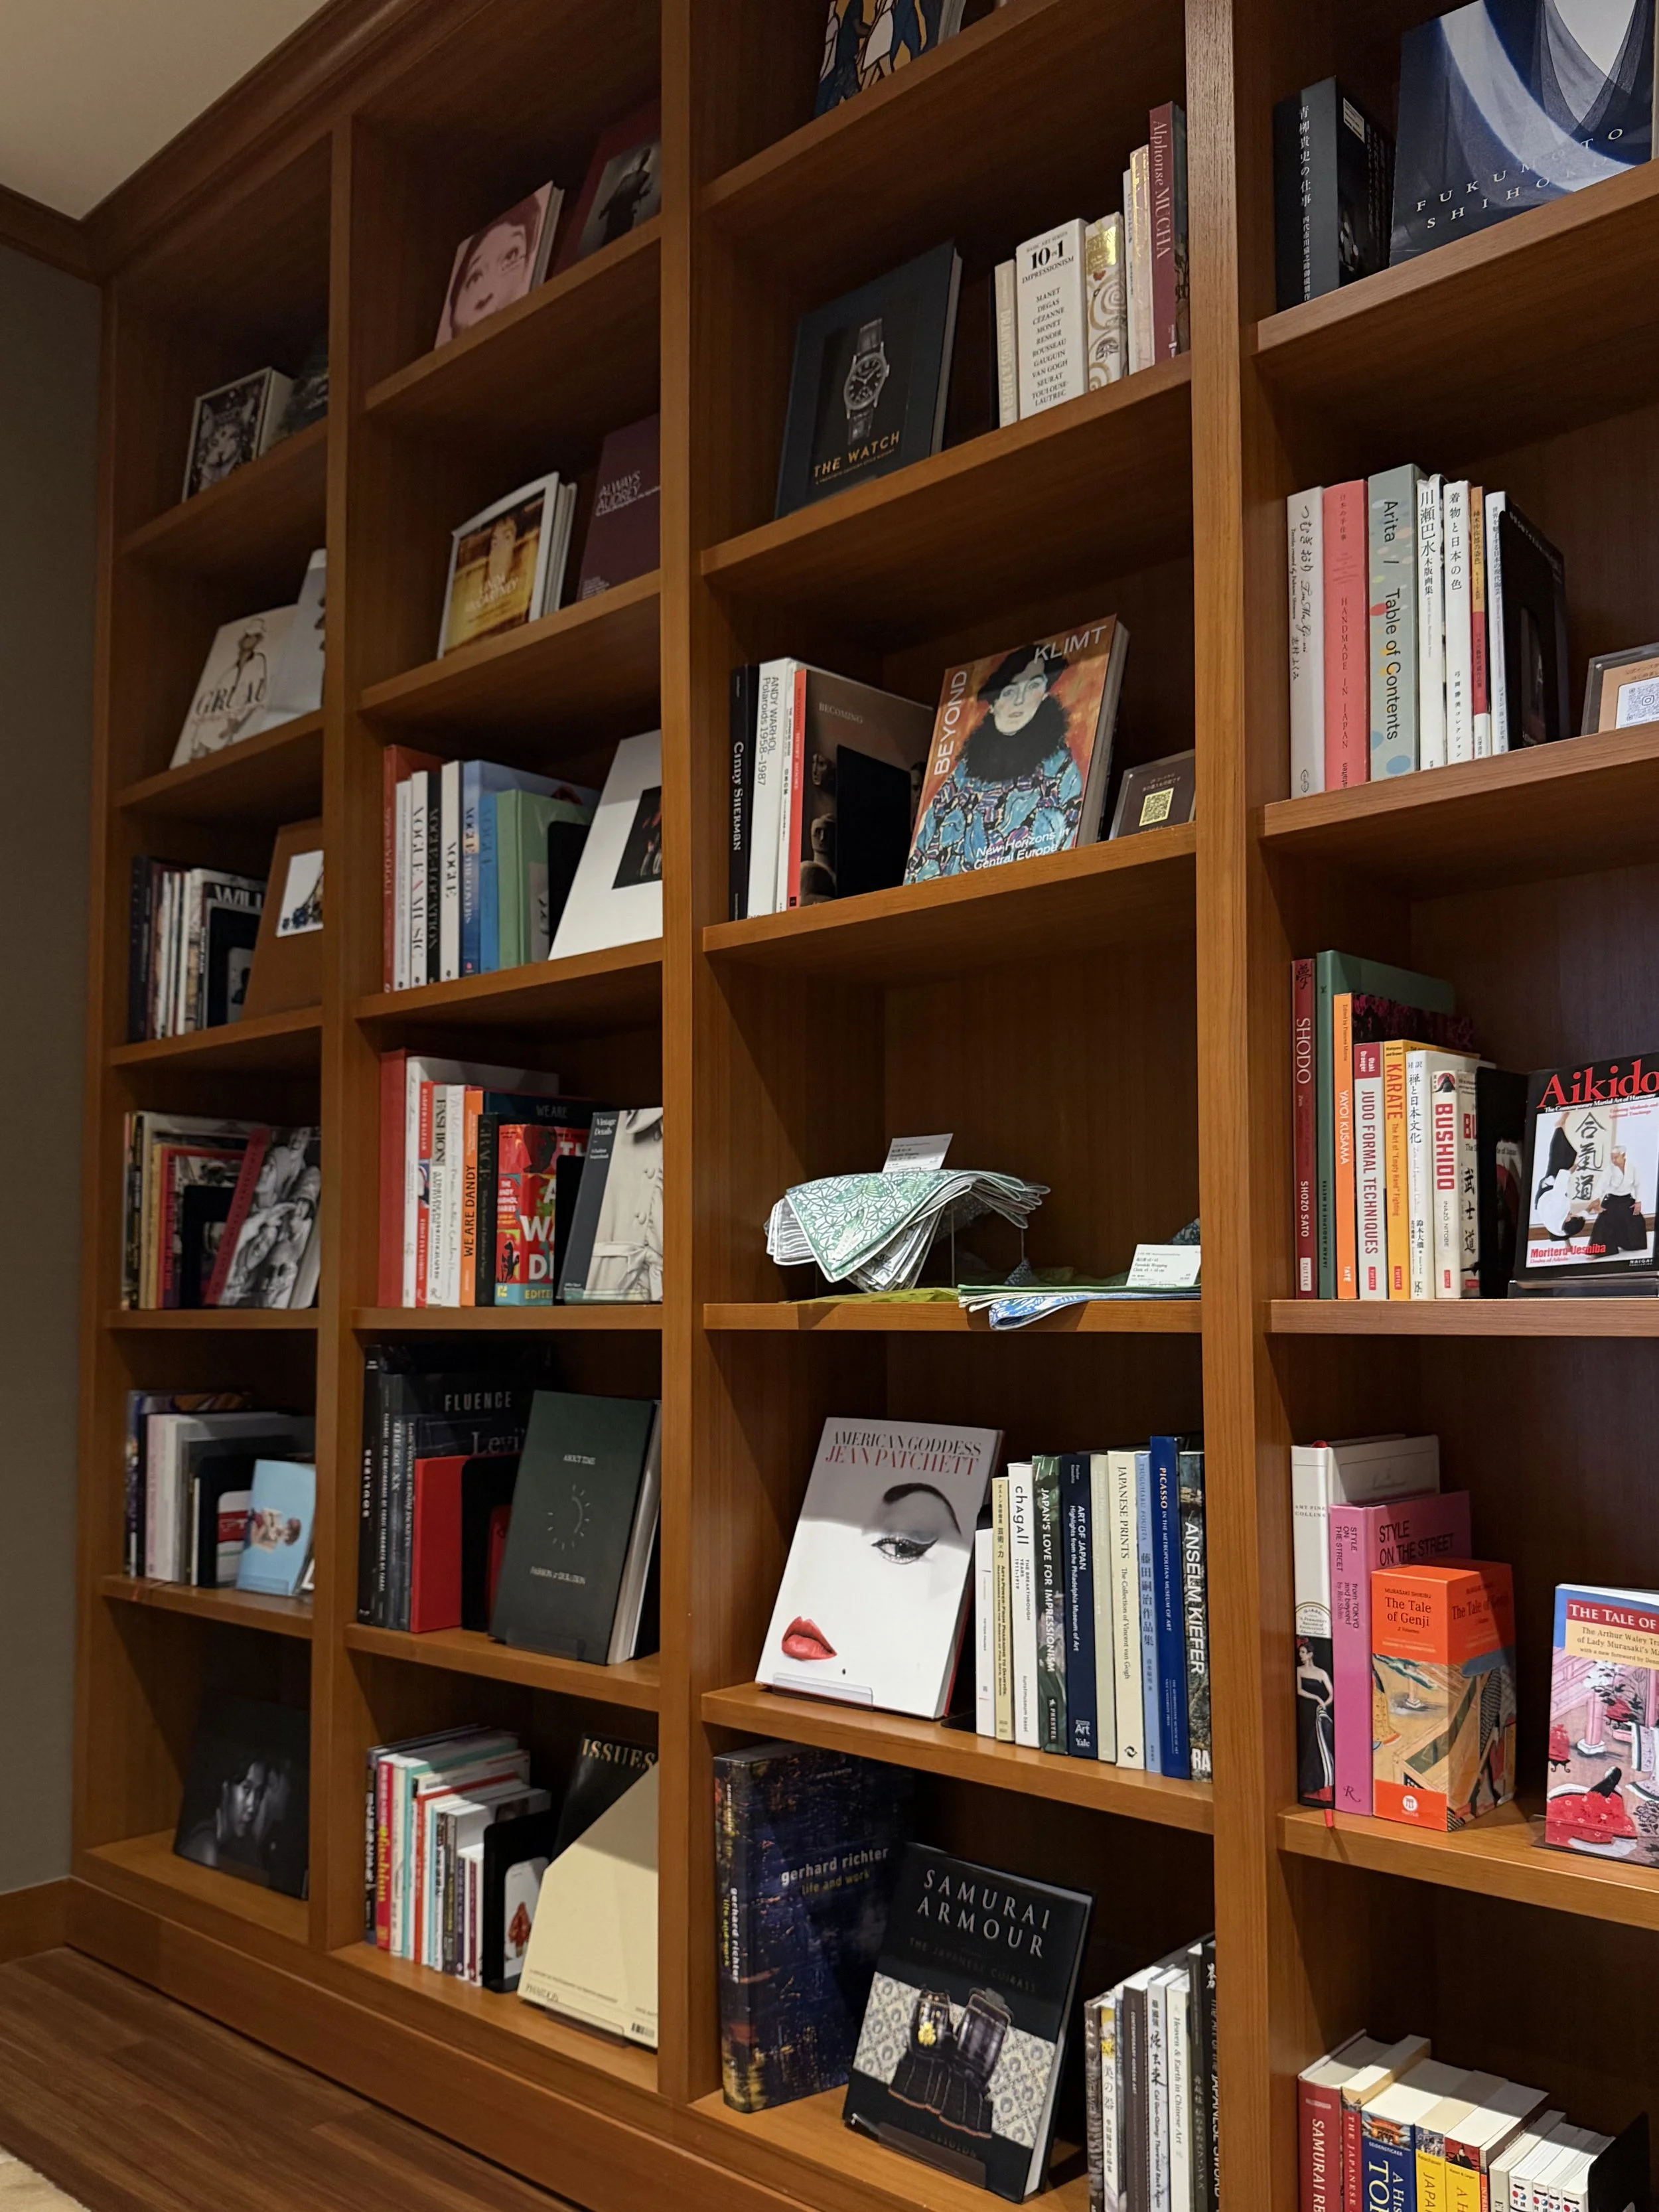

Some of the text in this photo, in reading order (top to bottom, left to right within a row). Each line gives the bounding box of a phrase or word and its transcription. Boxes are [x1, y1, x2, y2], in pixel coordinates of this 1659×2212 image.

[1151, 120, 1172, 259] Alphonse MUCHA
[1022, 256, 1074, 284] IMPRESSIONISM
[1031, 246, 1050, 270] 10
[1035, 287, 1060, 303] MANET
[1037, 299, 1060, 313] DEGAS
[1036, 330, 1062, 345] RENOIR
[1037, 319, 1062, 334] MONET
[814, 457, 841, 478] THE
[848, 430, 900, 464] WATCH
[1299, 504, 1313, 573] つむぎおり
[1420, 489, 1436, 557] 川瀬巴水
[1449, 492, 1463, 591] 着物と日本の色
[1424, 557, 1434, 596] 木版画集
[1383, 500, 1402, 741] Arita Table of Contents
[1033, 625, 1107, 664] KLIMT
[760, 678, 771, 726] Polaroids
[1341, 679, 1348, 696] IN
[769, 676, 780, 755] ANDY WARHOL
[818, 701, 864, 725] BECOMING
[934, 670, 968, 776] BEYOND
[465, 806, 475, 854] VOGUE
[976, 830, 1056, 858] New Horizons
[446, 842, 457, 899] VOGUE
[974, 843, 1058, 870] Central Europe
[1296, 1017, 1312, 1084] SHODO
[1387, 1063, 1403, 1120] KARATE
[1536, 1059, 1659, 1109] Aikido
[1630, 1092, 1657, 1102] Harmony
[596, 1118, 617, 1127] Vintage
[1339, 1090, 1350, 1165] YAYOI KUSAMA
[1409, 1073, 1421, 1144] 禅と日本文化
[435, 1099, 447, 1165] FASHION
[479, 1120, 492, 1181] GRACE
[1435, 1103, 1455, 1191] BUSHIDO
[1362, 1090, 1378, 1254] JUDO FORMAL TECHNIQUES
[1572, 1112, 1607, 1201] 合氣道
[465, 1165, 476, 1257] WE ARE DANDY
[1300, 1180, 1309, 1238] SHOZO SATO
[1463, 1167, 1476, 1254] 武士道
[445, 1391, 512, 1412] FLUENCE
[826, 1445, 979, 1476] JEAN PATCHETT
[835, 1431, 982, 1457] AMERICAN GODDESS
[1118, 1466, 1128, 1520] JAPANESE
[1159, 1467, 1168, 1509] PICASSO
[1077, 1505, 1087, 1570] ART OF JAPAN
[1120, 1520, 1129, 1559] PRINTS
[1343, 1526, 1350, 1538] ON
[1379, 1520, 1410, 1544] STYLE
[1379, 1532, 1454, 1567] ON THE STREET
[1043, 1534, 1056, 1672] LOVE FOR IMPRESSIONISM
[1141, 1552, 1154, 1646] 藤田嗣治作品集
[1185, 1522, 1205, 1675] ANSELM KIEFER
[1385, 1596, 1431, 1613] The Tale
[1569, 1603, 1657, 1630] THE TALE OF
[1387, 1611, 1430, 1629] of Genji
[1581, 1627, 1647, 1645] The Arthur Waley
[1587, 1637, 1648, 1654] Lady Murasaki's
[1074, 1724, 1090, 1735] Art
[1076, 1737, 1090, 1747] Yale
[583, 1738, 656, 1770] ISSUES
[781, 1848, 889, 1887] gerhard richter
[802, 1871, 870, 1896] life and work
[730, 1887, 739, 1938] gerhard
[924, 1868, 1050, 1931] SAMURAI
[917, 1896, 1043, 1958] ARMOUR
[1311, 2118, 1326, 2191] SAMURAI
[1368, 2141, 1404, 2157] SEIDENSTICKER
[1416, 2153, 1442, 2166] Reischauer
[1347, 2144, 1356, 2207] JAPANESE
[1392, 2171, 1404, 2183] A
